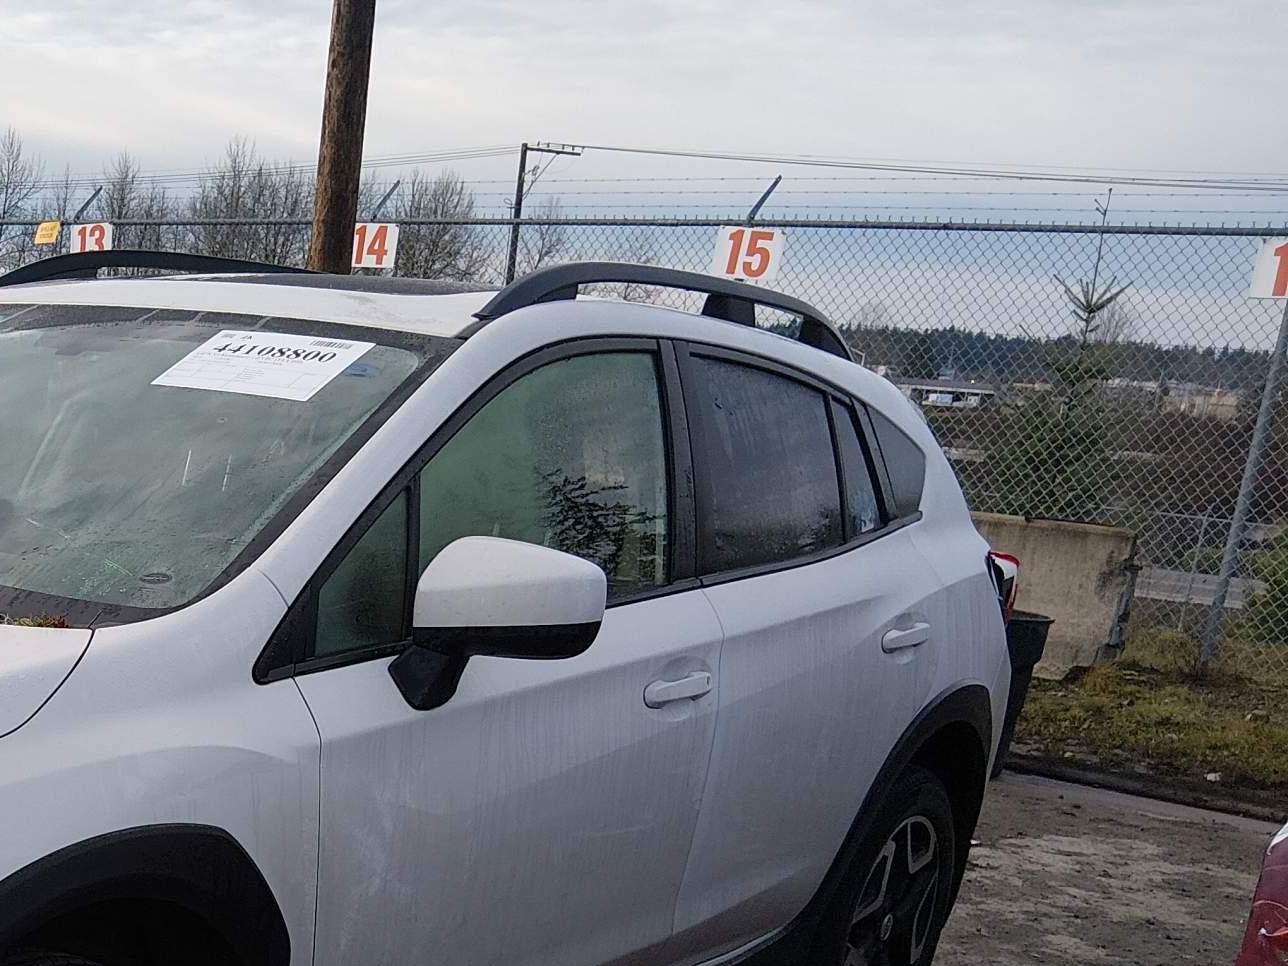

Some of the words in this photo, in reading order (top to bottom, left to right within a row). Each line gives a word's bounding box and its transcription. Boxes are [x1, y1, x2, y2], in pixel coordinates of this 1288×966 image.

[78, 224, 105, 252] 13
[355, 225, 388, 265] 14
[726, 229, 775, 278] 15
[213, 343, 337, 363] 44108800
